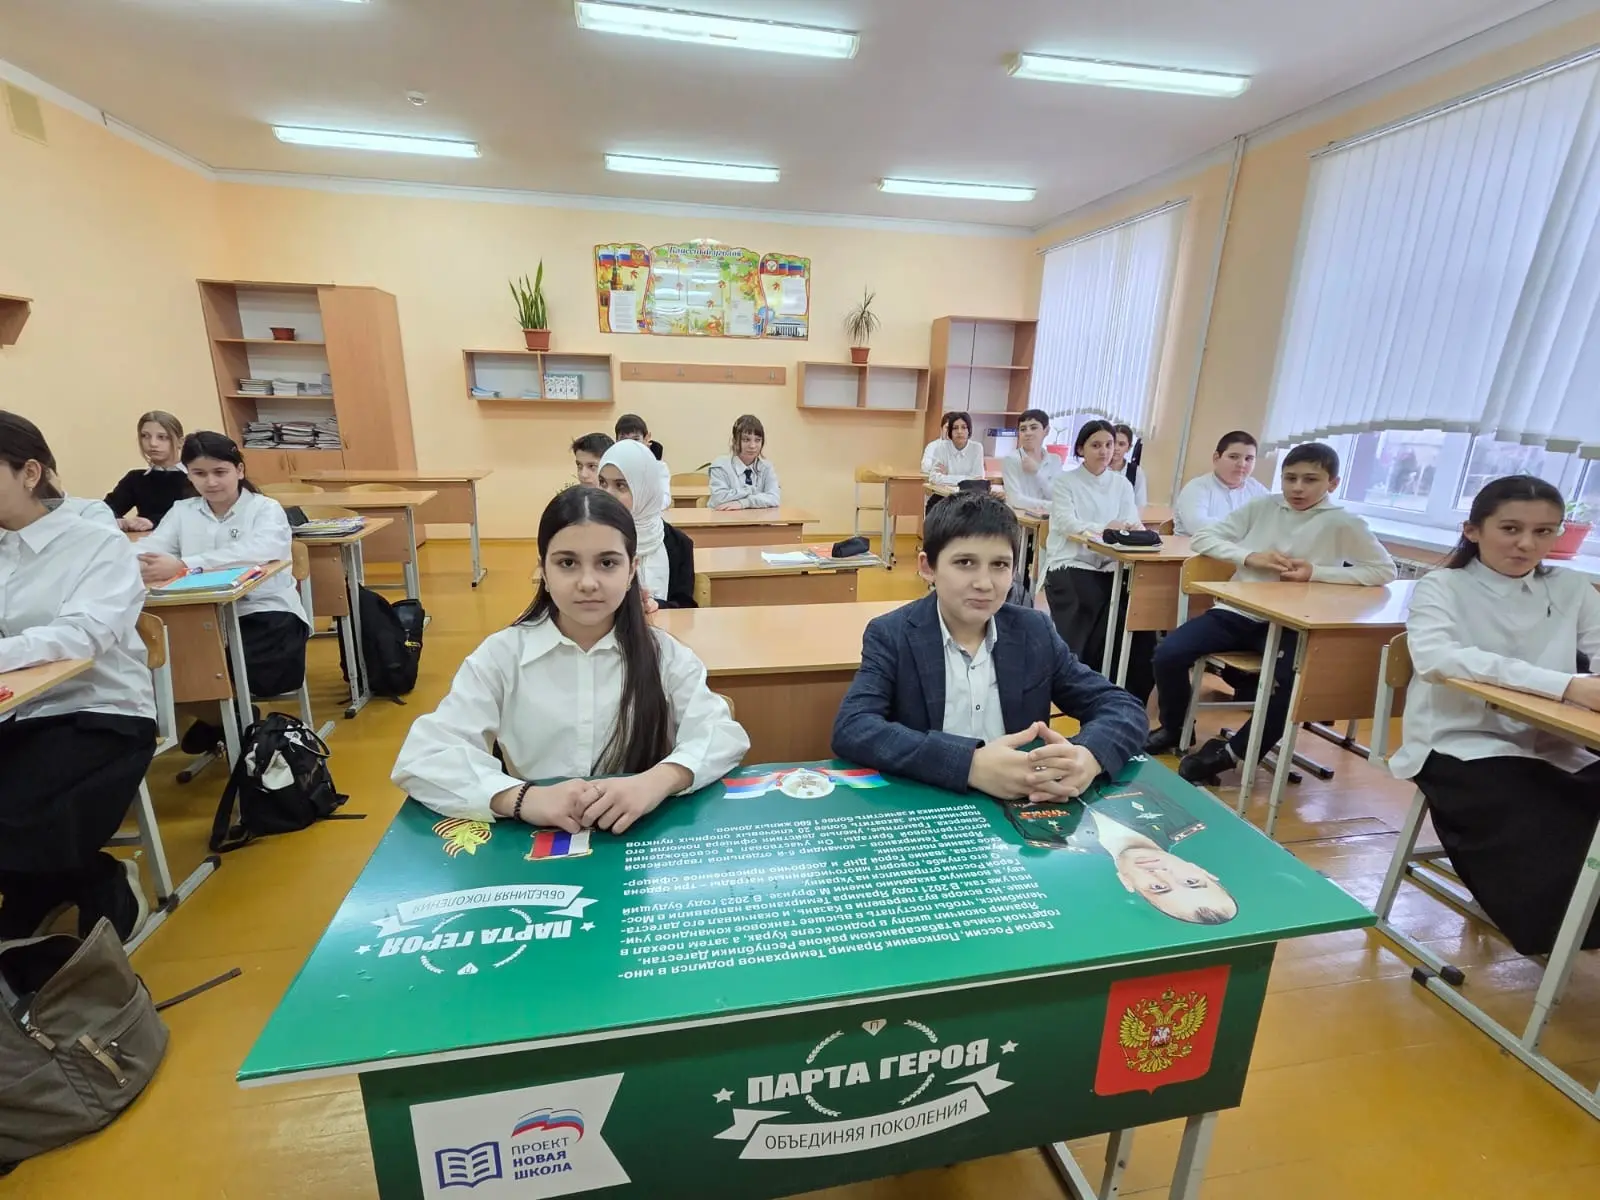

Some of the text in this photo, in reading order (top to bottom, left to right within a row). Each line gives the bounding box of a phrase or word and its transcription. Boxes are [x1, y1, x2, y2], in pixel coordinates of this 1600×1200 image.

[942, 862, 985, 871] России
[985, 859, 1021, 868] Герой
[871, 867, 941, 879] отправился
[938, 870, 991, 880] военную
[1007, 874, 1033, 882] нец
[874, 876, 937, 887] академию
[960, 879, 986, 887] там.
[986, 876, 1010, 884] уже
[833, 883, 872, 892] имени
[889, 887, 918, 895] году
[920, 884, 949, 893] 2021
[1002, 883, 1040, 891] лище.
[752, 894, 761, 902] В
[832, 889, 889, 901] Ярамира
[917, 893, 939, 901] вуз
[940, 889, 983, 898] вскоре
[974, 891, 1048, 904] Челябинск,
[412, 889, 566, 914] ОБЪЕДИНЯЯ ПОКОЛЕНИЯ
[686, 899, 715, 908] году
[720, 895, 749, 905] 2023
[745, 896, 830, 911] Темирханова
[855, 896, 915, 908] перевели
[934, 899, 974, 909] чтобы
[622, 902, 682, 916] будущий
[669, 906, 741, 919] направили
[793, 904, 842, 915] Казань,
[865, 904, 933, 917] поступать
[987, 901, 1039, 912] Ярамир
[708, 911, 779, 925] оканчивал
[799, 913, 852, 925] высшее
[889, 914, 931, 924] школу
[933, 907, 987, 919] окончил
[1002, 909, 1061, 923] годетной
[621, 915, 653, 924] Мос-
[683, 920, 704, 928] его
[734, 919, 797, 932] танковое
[824, 919, 876, 932] родном
[961, 916, 1002, 926] семье
[620, 921, 679, 935] дагеста-
[655, 927, 730, 941] командное
[790, 926, 822, 936] селе
[849, 922, 951, 940] табасаранском
[378, 919, 573, 958] ПАРТА ГЕРОЯ
[620, 934, 650, 945] учи-
[743, 930, 787, 941] Курак,
[798, 933, 847, 946] районе
[633, 942, 683, 954] поехал
[688, 937, 728, 948] затем
[711, 940, 795, 957] Республики
[617, 921, 1054, 980] Герой России, Полковник Ярамир Темирханов родился в мно-
[637, 949, 708, 965] Дагестан.
[747, 1038, 989, 1104] ПАРТА ГЕРОЯ
[765, 1099, 968, 1151] ОБЪЕДИНЯЯ ПОКОЛЕНИЯ
[511, 1137, 570, 1156] ПРОЕКТ
[513, 1150, 567, 1168] НОВАЯ
[514, 1162, 573, 1180] ШКОЛА
